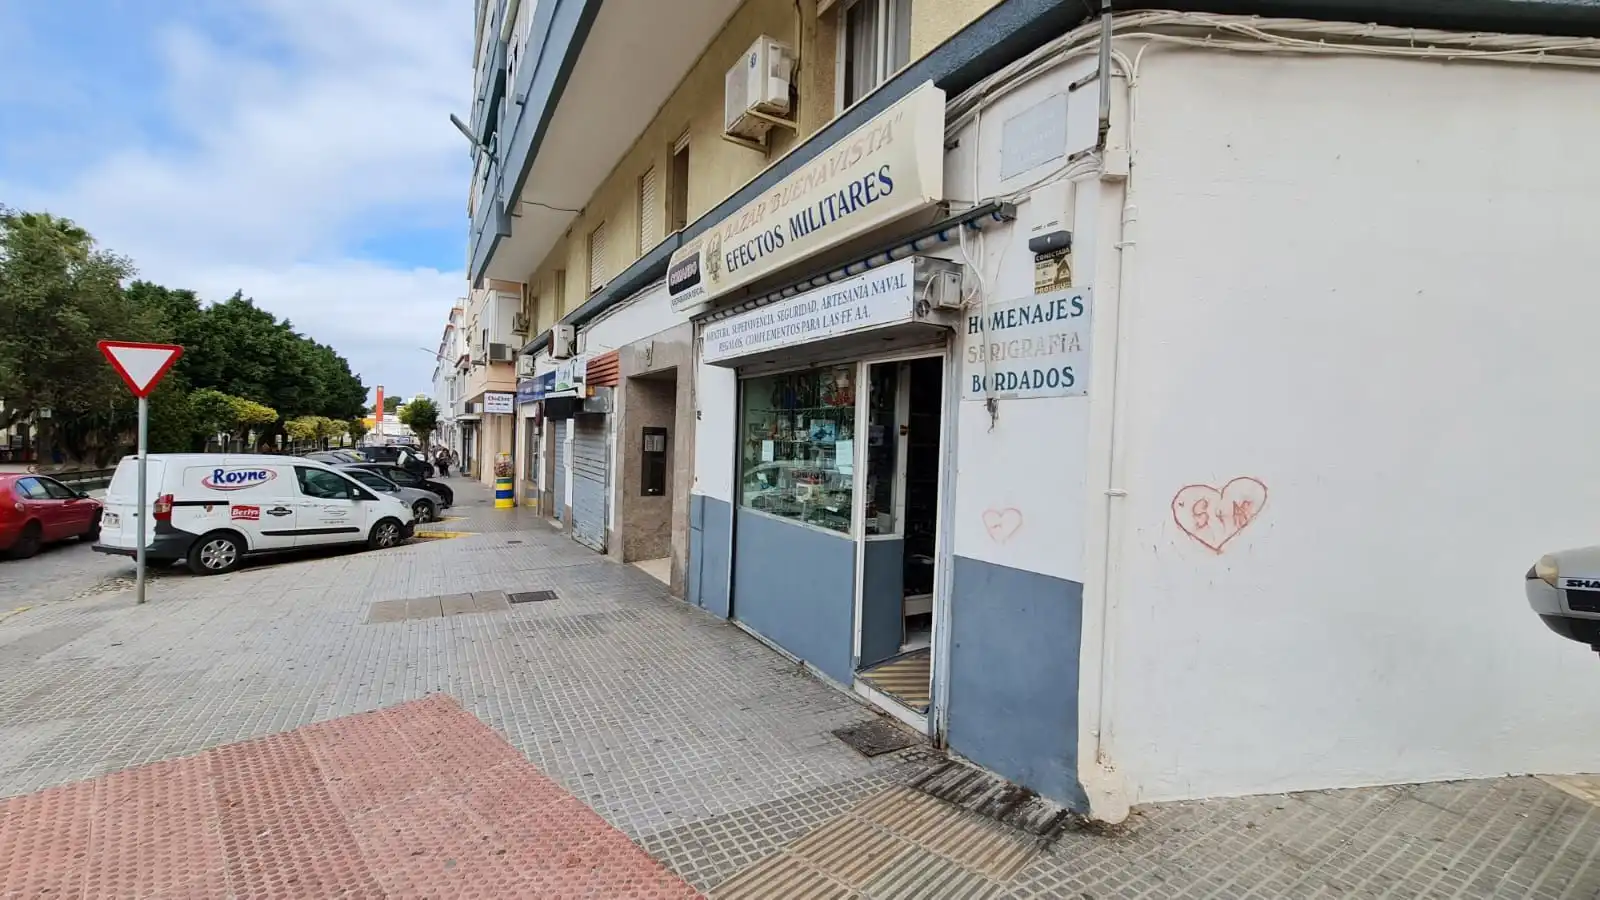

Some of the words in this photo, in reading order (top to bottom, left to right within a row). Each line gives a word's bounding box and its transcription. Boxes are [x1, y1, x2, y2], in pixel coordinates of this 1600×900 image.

[726, 225, 785, 273] EFECTOS
[789, 164, 894, 243] MILITARES
[777, 299, 819, 322] SEGURIDAD,
[871, 273, 907, 296] NAVAL
[968, 295, 1084, 335] HOMENAJES
[745, 322, 800, 345] COMPLEMENTOS
[802, 317, 821, 333] PARA
[823, 311, 840, 328] LAS
[972, 366, 1075, 393] BORDADOS
[213, 468, 267, 484] Royne
